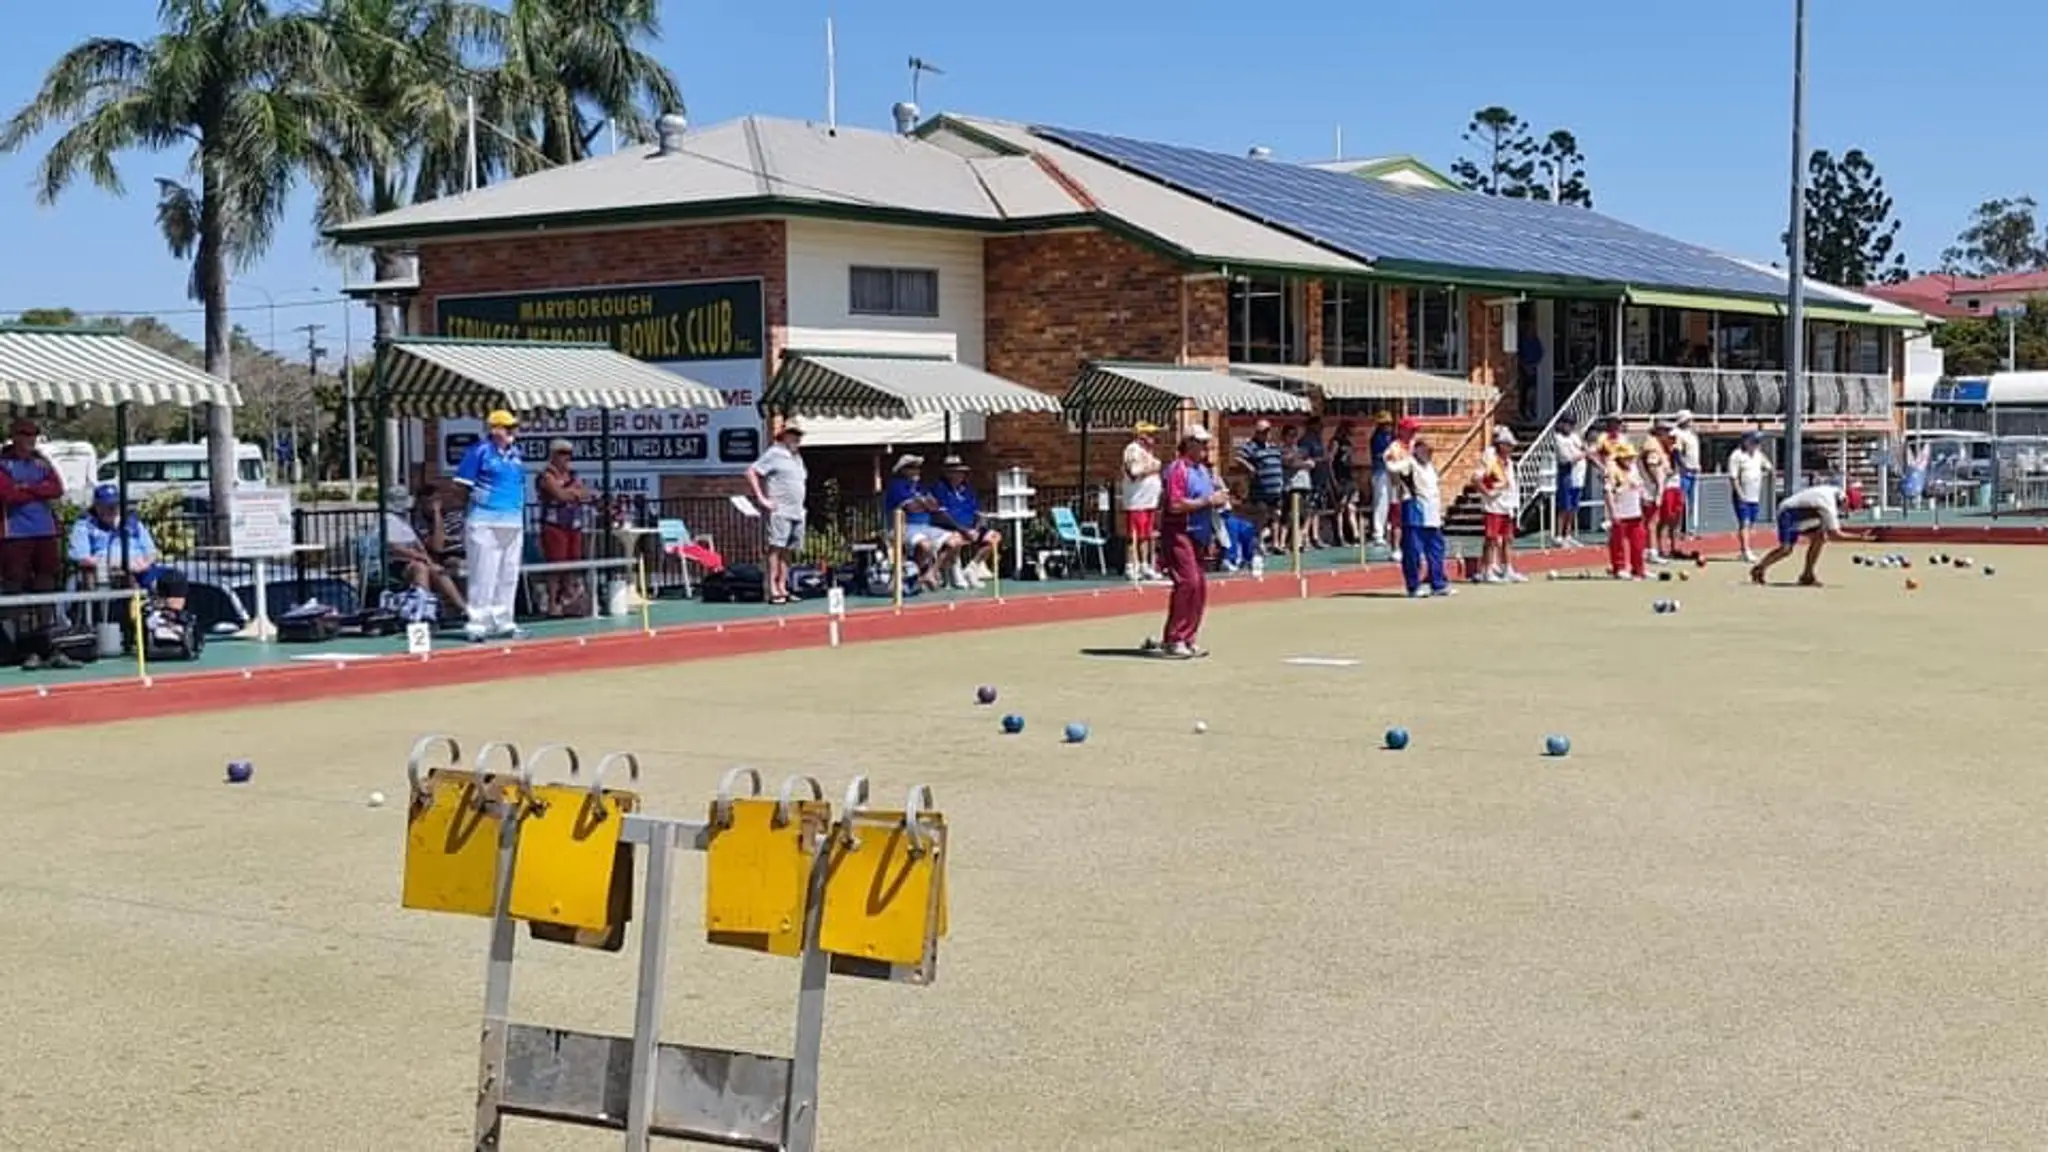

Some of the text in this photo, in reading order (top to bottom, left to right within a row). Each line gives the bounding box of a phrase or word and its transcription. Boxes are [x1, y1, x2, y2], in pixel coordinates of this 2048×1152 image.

[520, 295, 653, 319] MARYBOROUGH
[620, 313, 680, 355] BOWLS
[686, 300, 732, 354] CLUB
[576, 415, 626, 431] BER
[632, 414, 662, 430] ON
[669, 412, 709, 429] TAP
[609, 438, 629, 458] ON
[632, 438, 660, 457] WED
[663, 438, 673, 456] &
[675, 437, 700, 456] SAT
[413, 628, 426, 646] 2
